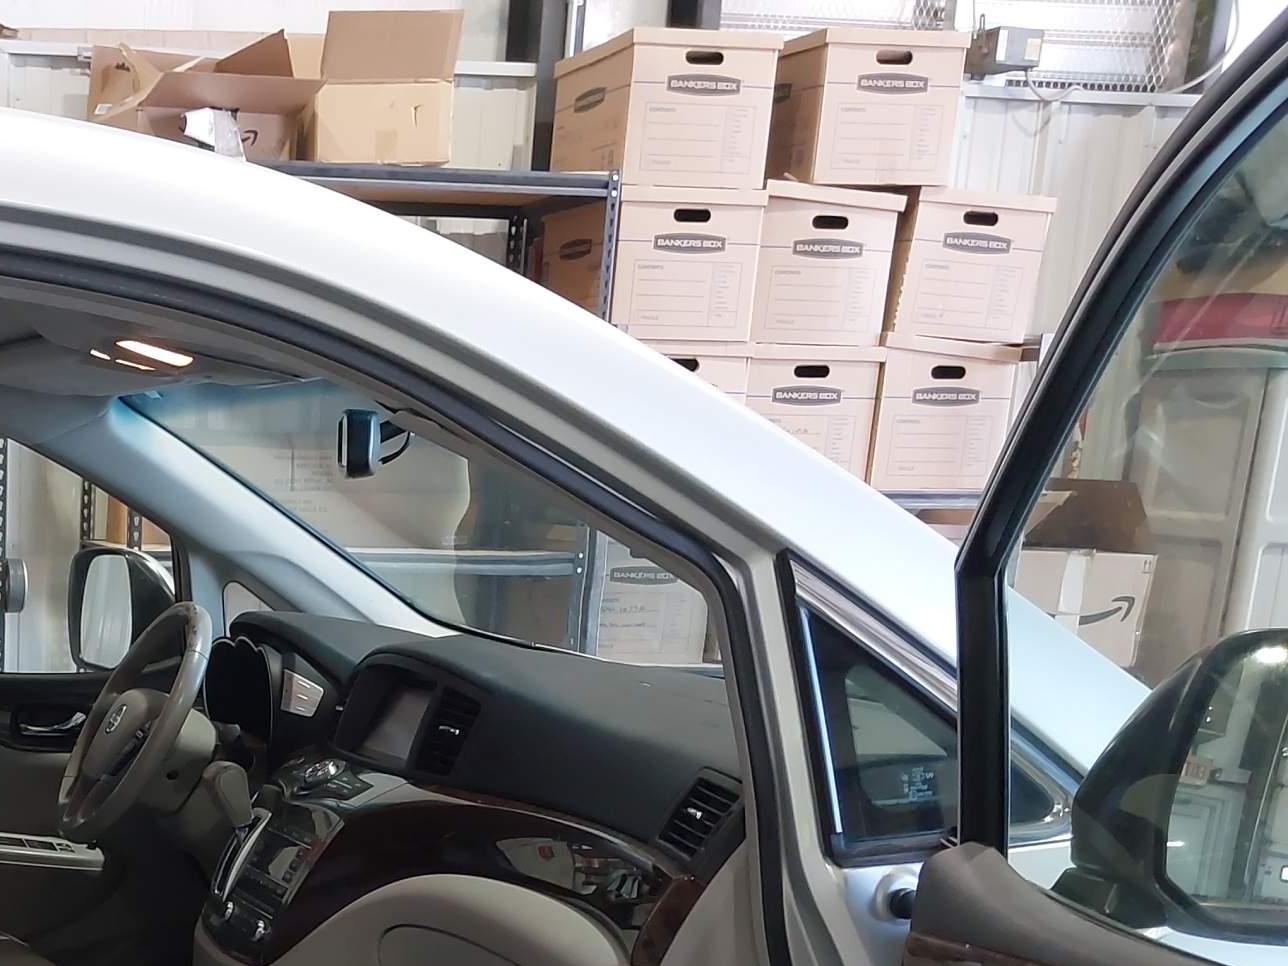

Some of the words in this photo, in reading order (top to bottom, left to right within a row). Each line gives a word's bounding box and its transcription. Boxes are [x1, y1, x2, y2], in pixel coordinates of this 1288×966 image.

[670, 80, 716, 90] BANKERS
[717, 82, 738, 91] BOX
[860, 79, 904, 88] BANKERS
[905, 80, 926, 89] BOX
[657, 239, 702, 248] BANKERS
[703, 240, 723, 248] BOX
[796, 243, 841, 253] BANKERS
[841, 245, 861, 254] BOX
[946, 237, 988, 248] BANKERS
[989, 241, 1008, 250] BOX
[775, 391, 818, 400] BANKERS
[819, 392, 839, 400] BOX
[915, 392, 957, 400] BANKERS
[958, 393, 977, 401] BOX
